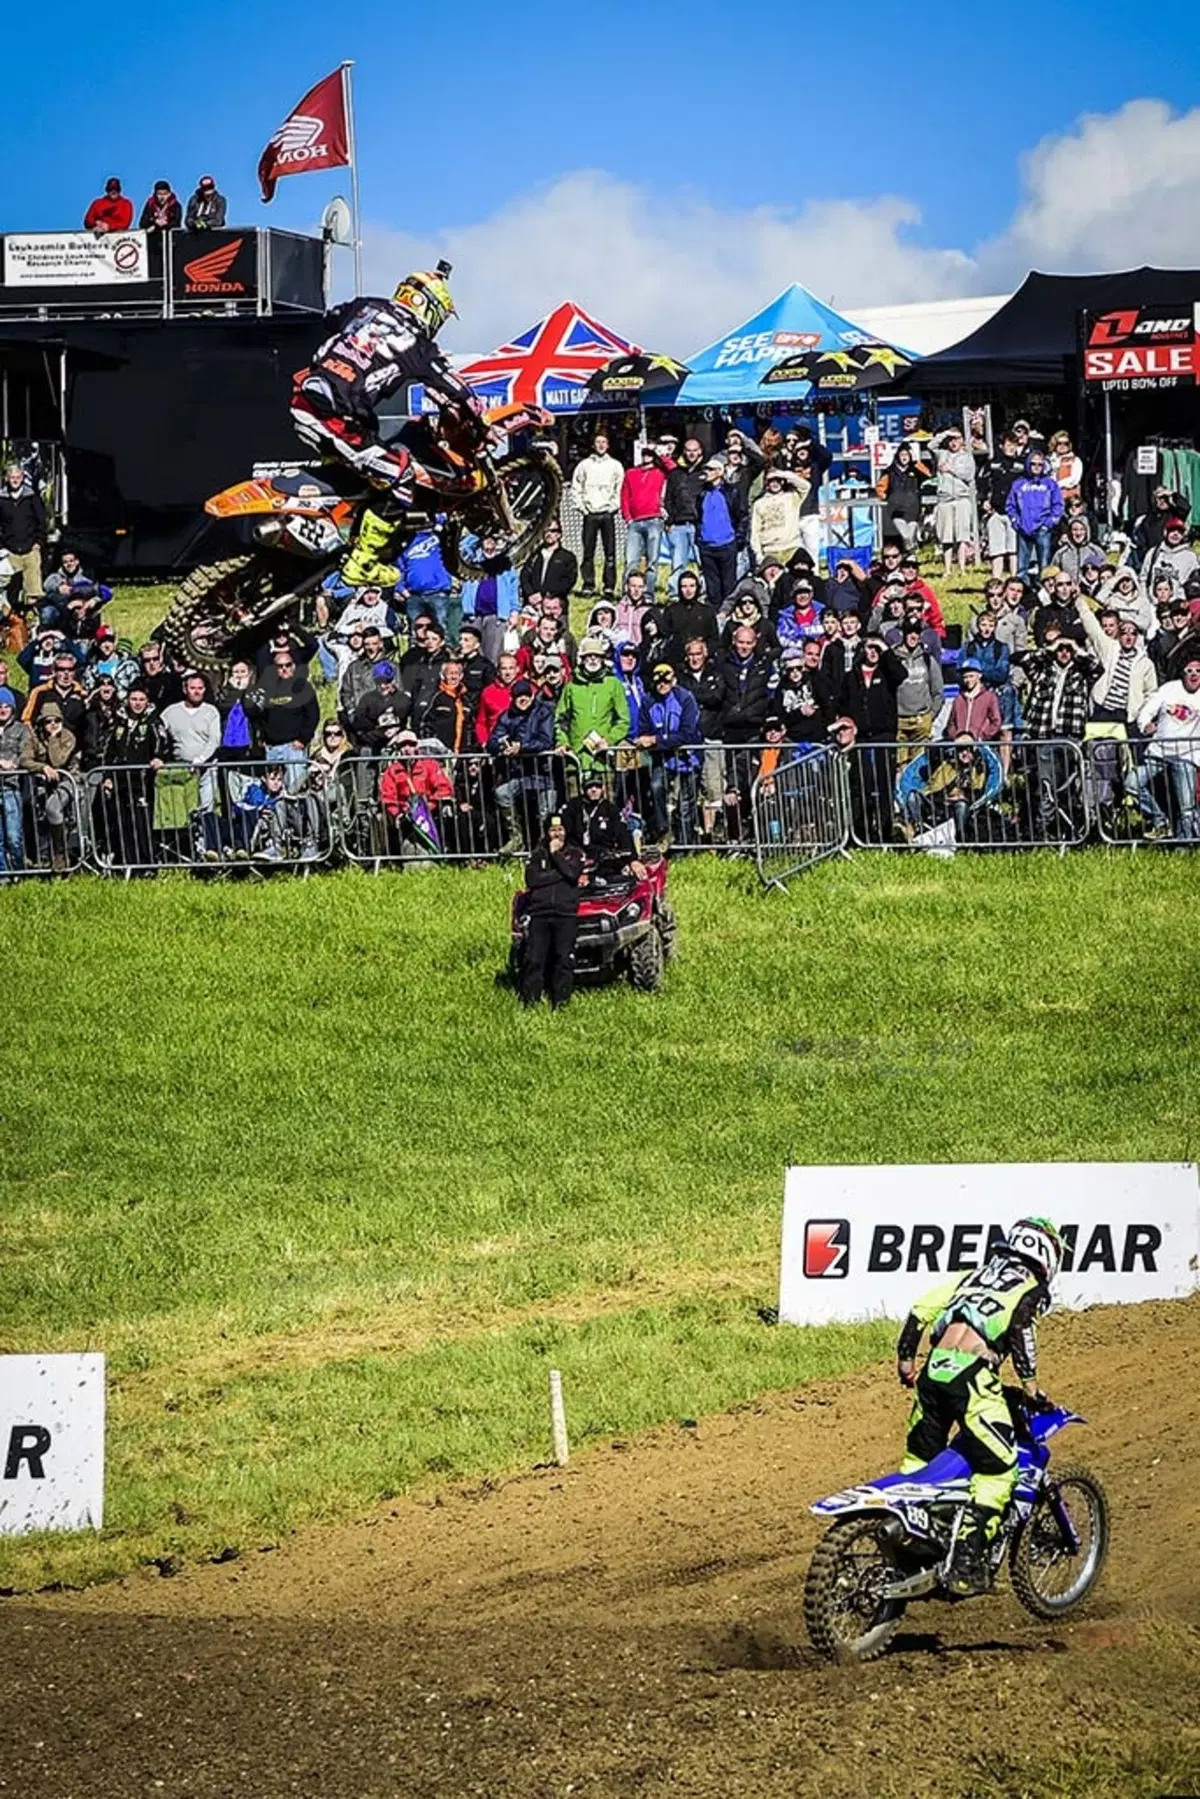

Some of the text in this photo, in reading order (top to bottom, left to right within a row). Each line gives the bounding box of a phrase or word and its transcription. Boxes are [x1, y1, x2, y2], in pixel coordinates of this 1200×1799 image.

[184, 282, 245, 293] HONDA
[720, 330, 774, 354] SEE
[1087, 347, 1193, 376] SALE
[1159, 377, 1178, 388] OFF
[3, 1425, 52, 1480] R
